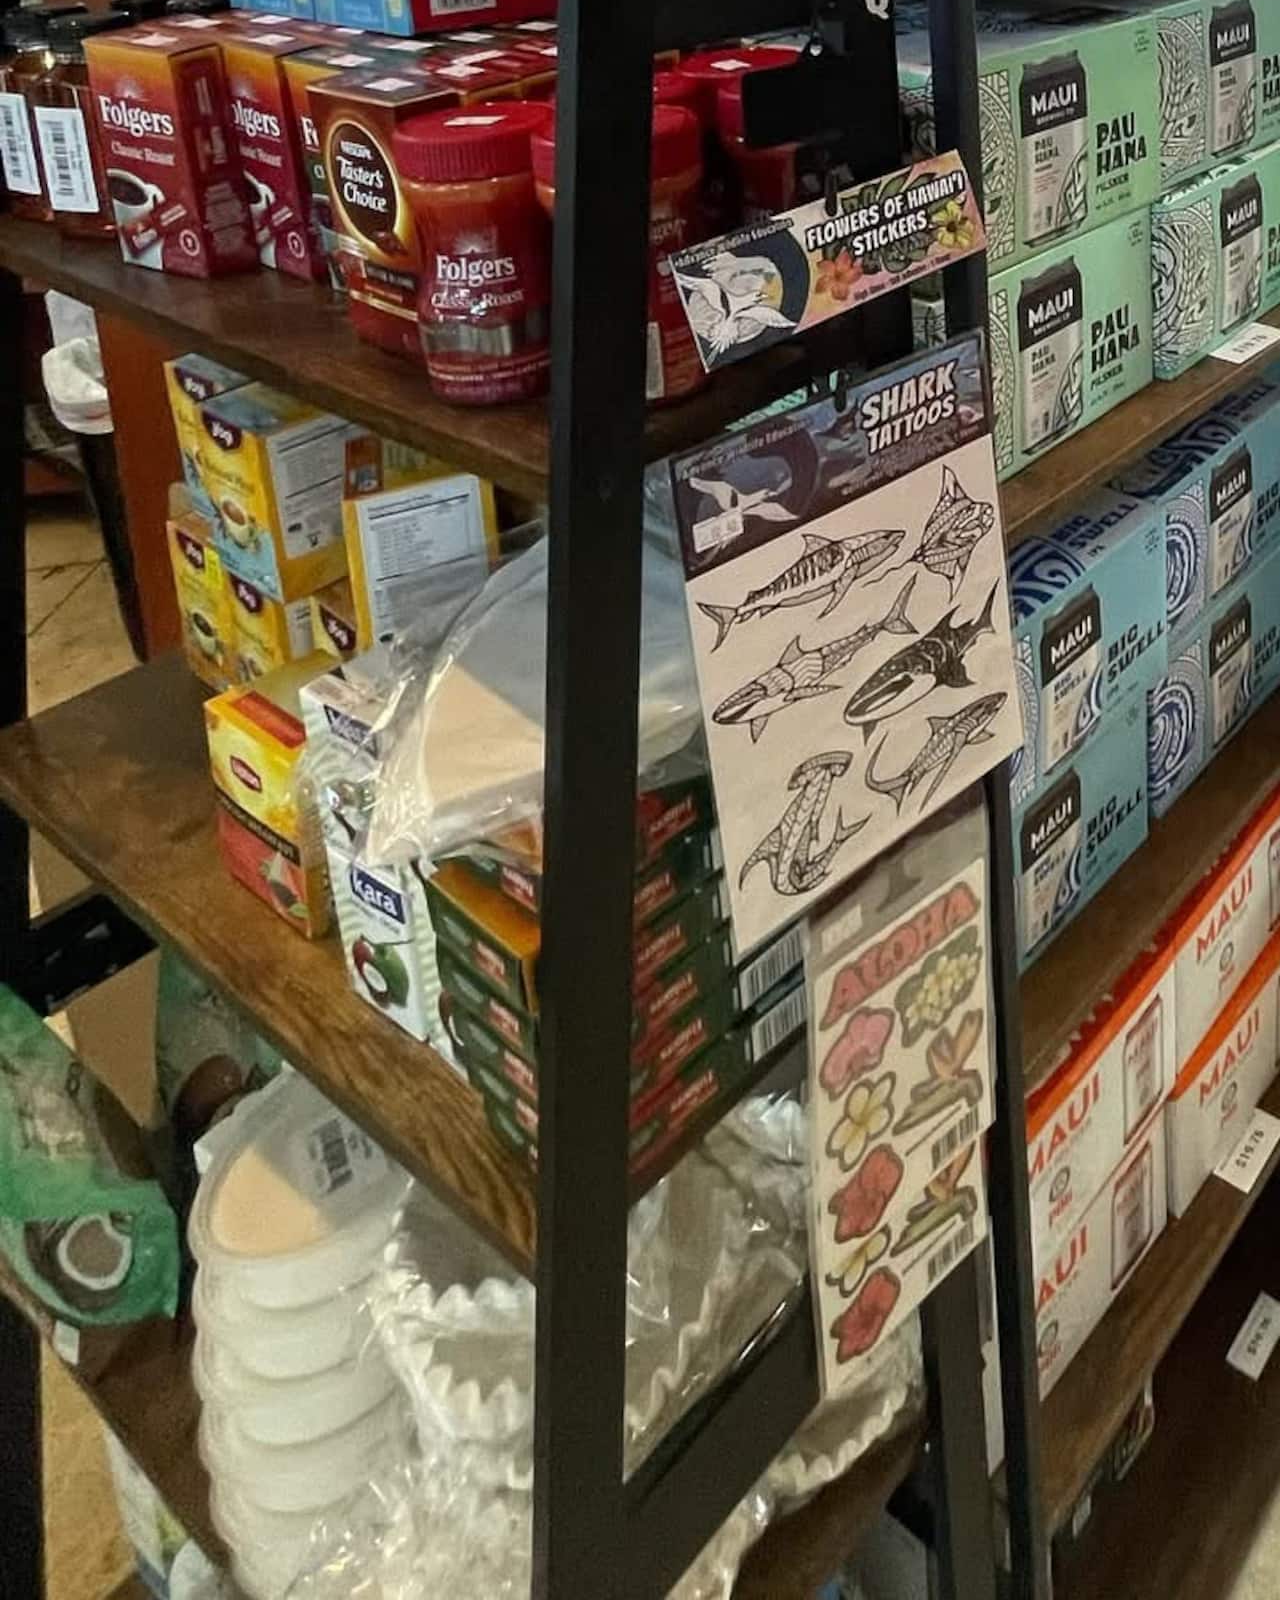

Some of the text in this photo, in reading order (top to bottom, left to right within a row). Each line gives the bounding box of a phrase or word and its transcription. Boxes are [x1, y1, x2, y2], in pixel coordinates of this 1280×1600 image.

[1217, 23, 1250, 49] MAUI
[99, 94, 175, 138] Folgers
[1031, 82, 1078, 117] MAUI
[1096, 111, 1135, 149] PAU
[335, 154, 384, 189] Taster's
[1096, 135, 1148, 177] HANA
[343, 181, 388, 212] Choice
[1226, 199, 1258, 230] MAUI
[806, 203, 881, 252] FLOWERS
[883, 196, 905, 219] OF
[851, 211, 928, 257] STICKERS
[436, 254, 516, 288] Folgers
[1027, 287, 1074, 329] MAUI
[1090, 303, 1130, 347] PAU
[1091, 323, 1141, 373] HANA
[861, 359, 957, 429] SHARK
[867, 394, 957, 455] TATTOOS
[1217, 469, 1246, 506] MAUI
[1257, 481, 1280, 513] BIG
[1066, 502, 1139, 550] SWELL
[1051, 615, 1093, 665] MAUI
[1107, 619, 1166, 685] SWELL
[1108, 623, 1139, 665] BIG
[1215, 617, 1246, 658] MAUI
[1030, 796, 1073, 850] MAUI
[1086, 787, 1143, 859] SWELL
[1087, 794, 1118, 835] BIG
[354, 868, 399, 917] kara
[1196, 866, 1253, 964] MAUI
[819, 880, 981, 1032] ALOHA
[1200, 1006, 1260, 1103] MAUI
[1036, 1223, 1089, 1313] AUI
